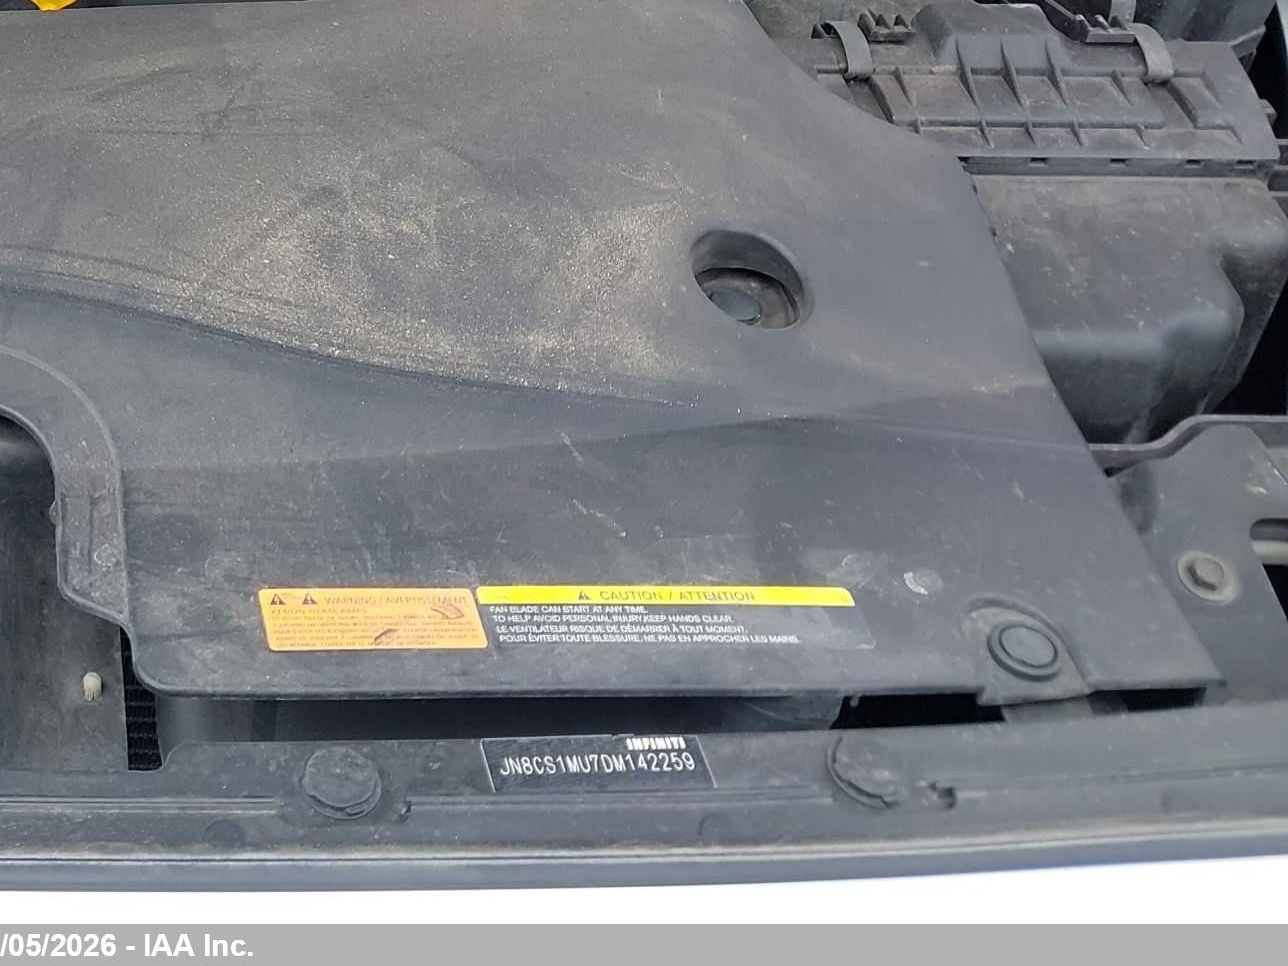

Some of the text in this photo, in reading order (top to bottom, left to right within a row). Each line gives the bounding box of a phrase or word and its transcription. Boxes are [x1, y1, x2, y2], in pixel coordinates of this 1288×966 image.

[599, 590, 662, 601] CAUTION
[679, 590, 756, 601] ATTENTION
[489, 605, 508, 613] FAN
[509, 605, 539, 613] BLADE
[541, 605, 561, 613] CAN
[562, 605, 590, 613] START
[593, 605, 603, 613] AT
[606, 605, 623, 613] ANY
[492, 614, 506, 622] TO
[507, 614, 532, 622] HELP
[533, 614, 561, 622] AVOID
[562, 614, 611, 622] PERSONAL
[668, 614, 701, 622] HANDS
[496, 624, 508, 633] LE
[509, 624, 569, 633] VENTILATEUR
[569, 624, 605, 633] RISQUE
[606, 624, 619, 633] DE
[679, 624, 704, 633] TOUT
[499, 634, 528, 642] POUR
[561, 634, 592, 642] TOUTE
[643, 634, 657, 642] NE
[657, 634, 676, 642] PAS
[677, 634, 691, 642] EN
[692, 634, 750, 642] APPROCHER
[750, 635, 768, 643] LES
[625, 736, 687, 751] INFINITI
[499, 751, 696, 776] JN8CS1MU7DM142259
